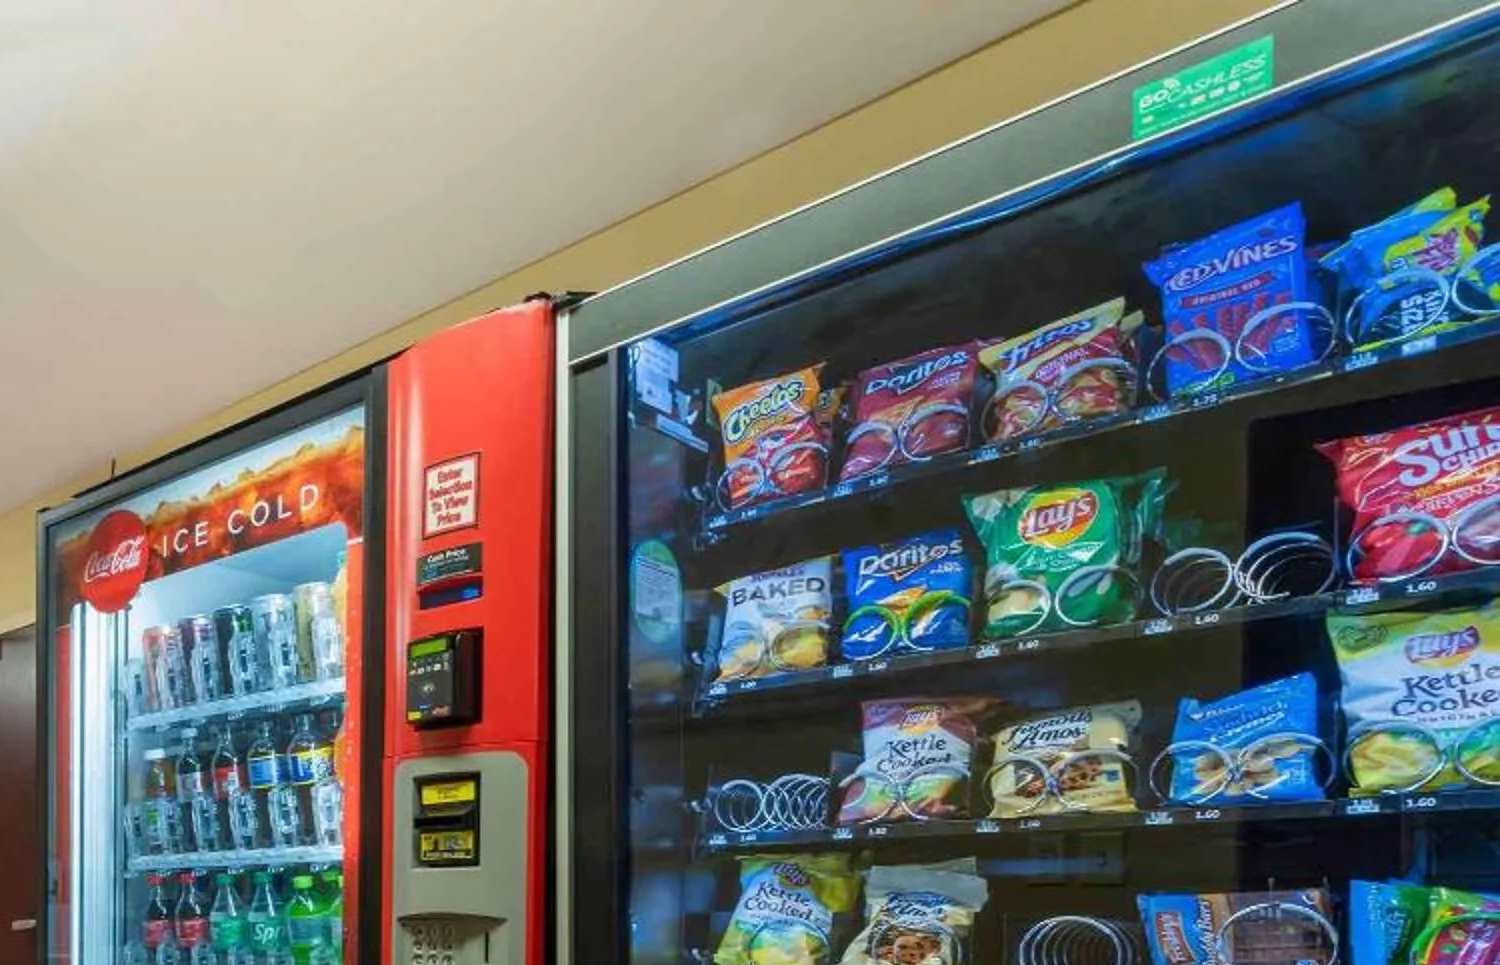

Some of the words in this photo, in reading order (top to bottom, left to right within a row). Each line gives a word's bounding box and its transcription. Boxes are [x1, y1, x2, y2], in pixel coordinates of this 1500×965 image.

[1213, 236, 1297, 273] VINES
[725, 381, 803, 441] Cheetos
[437, 468, 462, 483] Enter
[444, 496, 468, 509] View
[162, 521, 209, 557] ICE
[227, 484, 319, 534] COLD
[436, 512, 461, 526] Price
[859, 538, 964, 580] Doritos
[733, 577, 825, 607] BAKED
[1406, 581, 1436, 593] 1.60
[1195, 613, 1219, 624] 1.60
[887, 735, 947, 758] Kettle
[1405, 798, 1436, 808] 1.60
[1196, 809, 1220, 819] 1.60
